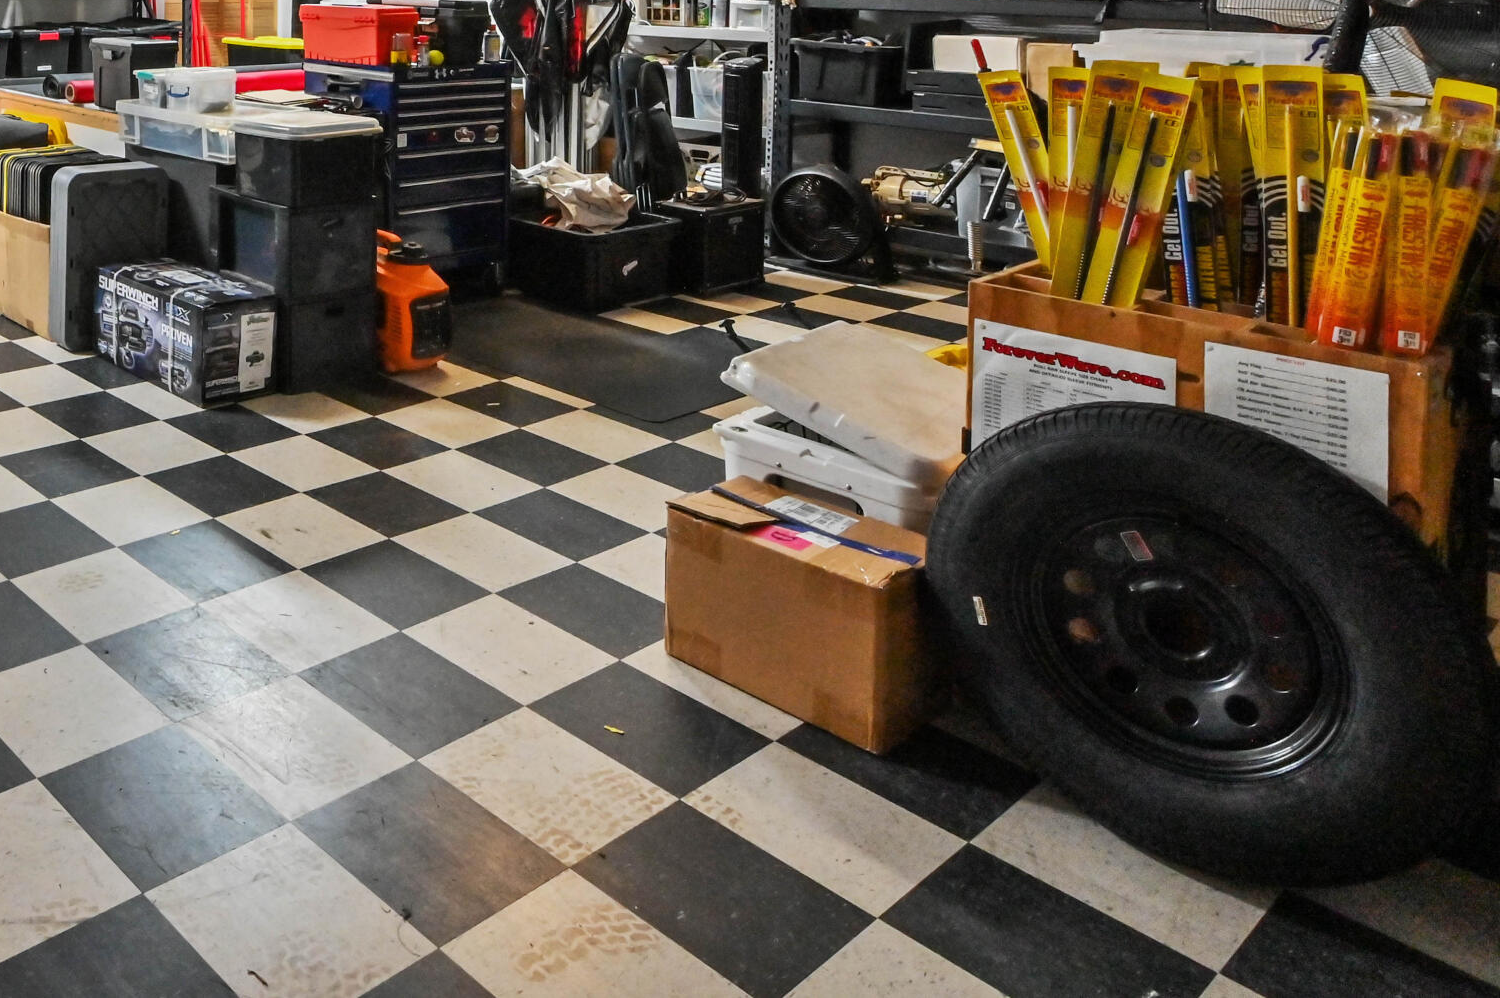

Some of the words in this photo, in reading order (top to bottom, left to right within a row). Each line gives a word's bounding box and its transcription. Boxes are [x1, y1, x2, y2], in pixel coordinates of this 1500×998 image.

[1163, 239, 1183, 261] Get
[1267, 244, 1288, 267] Get
[98, 274, 159, 306] SUPERWINCH
[161, 323, 193, 347] PROVEN
[982, 337, 1166, 390] ForeverWave.com
